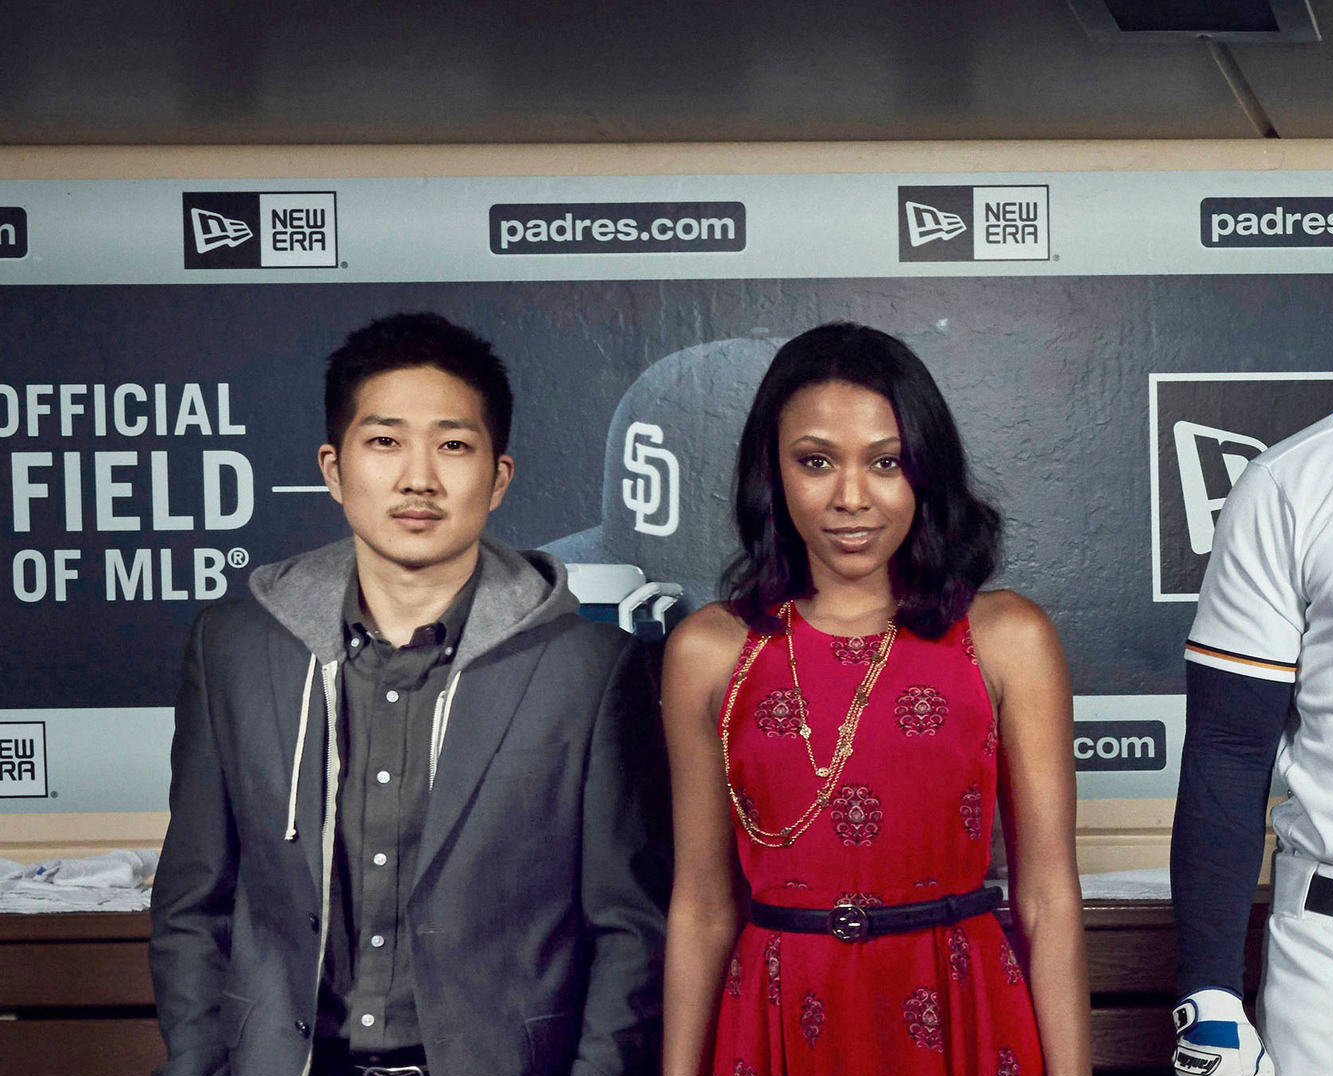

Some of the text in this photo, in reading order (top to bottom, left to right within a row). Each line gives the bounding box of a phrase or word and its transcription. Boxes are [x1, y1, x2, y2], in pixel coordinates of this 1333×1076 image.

[272, 209, 326, 229] NEW
[985, 202, 1038, 222] NEW
[272, 231, 326, 251] ERA
[500, 213, 735, 249] padres.com
[986, 224, 1038, 244] ERA
[11, 450, 254, 532] FIELD
[622, 421, 680, 537] SD
[12, 549, 82, 603] OF
